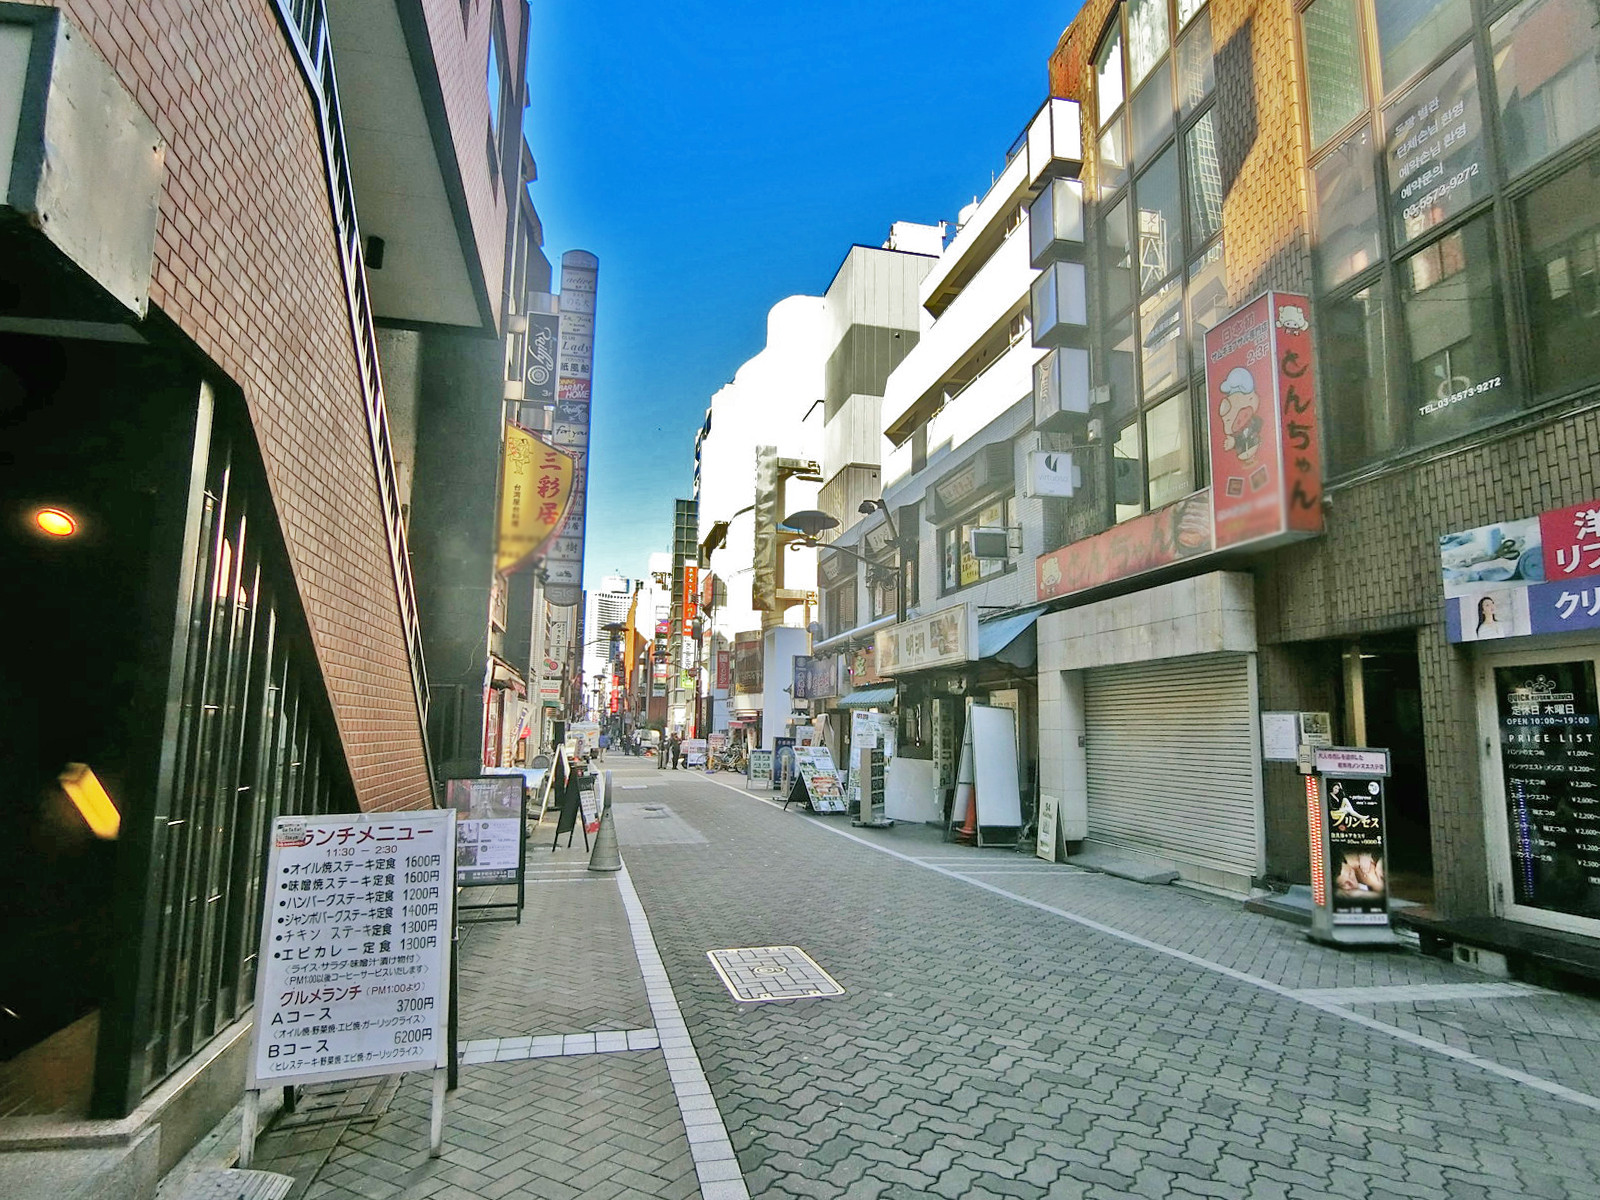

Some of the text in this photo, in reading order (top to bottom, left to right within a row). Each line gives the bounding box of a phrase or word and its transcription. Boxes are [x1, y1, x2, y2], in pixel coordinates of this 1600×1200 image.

[1396, 100, 1464, 159] 단체손님 환영
[1399, 122, 1467, 179] 예약손님 환영
[1401, 162, 1444, 199] 예약문의
[1402, 162, 1479, 220] 03-5573-9272
[562, 341, 592, 354] Lady
[565, 390, 590, 399] HOME
[1280, 349, 1317, 511] とんちゃん
[535, 452, 562, 525] 三彩居
[1508, 694, 1530, 702] QUICK
[1511, 703, 1575, 715] 定休日 木曜日
[1509, 733, 1593, 743] PRICE LIST
[301, 826, 434, 847] ランチメニュー
[326, 847, 355, 858] 11:30
[375, 845, 398, 855] 2:30
[290, 855, 440, 876] オイル焼ステーキ定食 1600円
[288, 871, 440, 892] 味噌焼ステーキ定食 1600円
[286, 887, 439, 909] ハンバーグステーキ定食 1200円
[401, 903, 438, 917] 1400円
[283, 920, 437, 943] チキン ステーキ定食 1300円
[281, 936, 437, 962] エビカレー定食 1300円
[280, 985, 362, 1008] グルメランチ
[271, 997, 434, 1026] Aコース 3700円
[268, 1028, 433, 1059] Bコース 6200円
